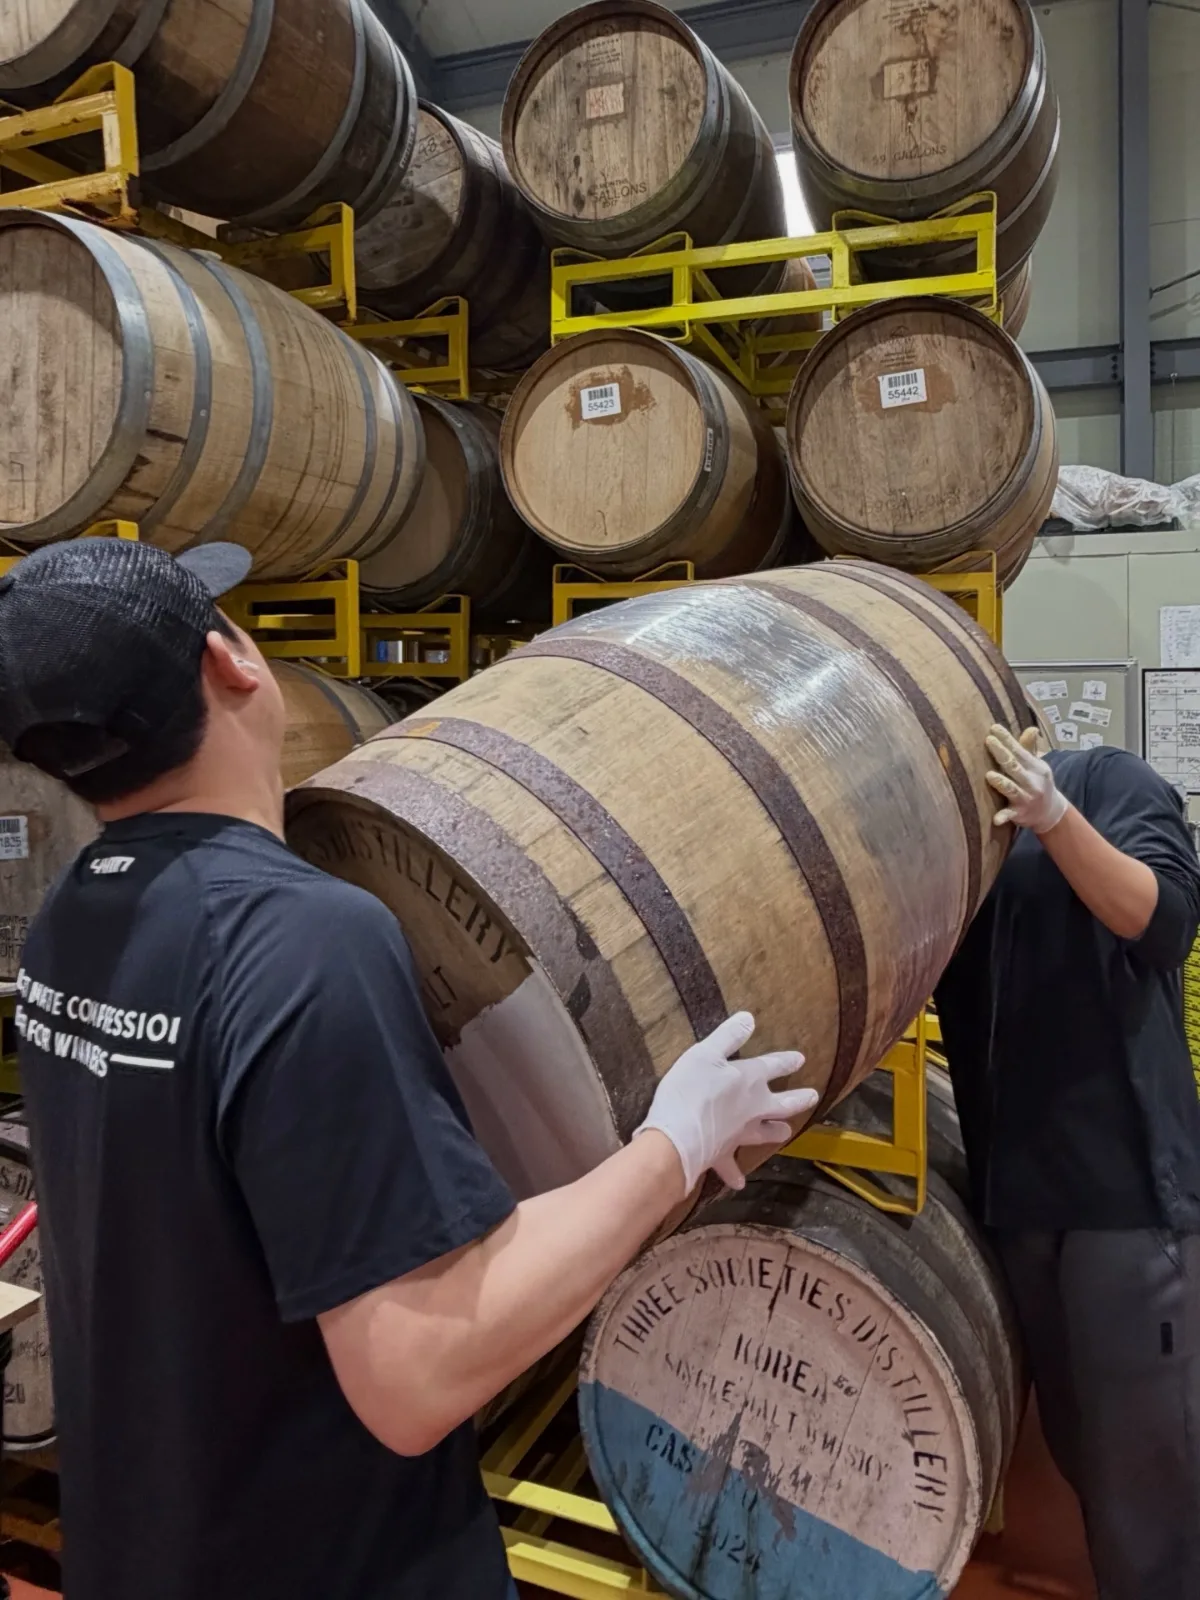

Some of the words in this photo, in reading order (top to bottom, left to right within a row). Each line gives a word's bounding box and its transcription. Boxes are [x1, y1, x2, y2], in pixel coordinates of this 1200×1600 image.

[587, 399, 616, 412] 55423
[887, 386, 920, 400] 55442
[612, 1273, 686, 1355] THREE
[686, 1256, 852, 1322] SOCIETIES
[645, 1423, 697, 1475] CAS
